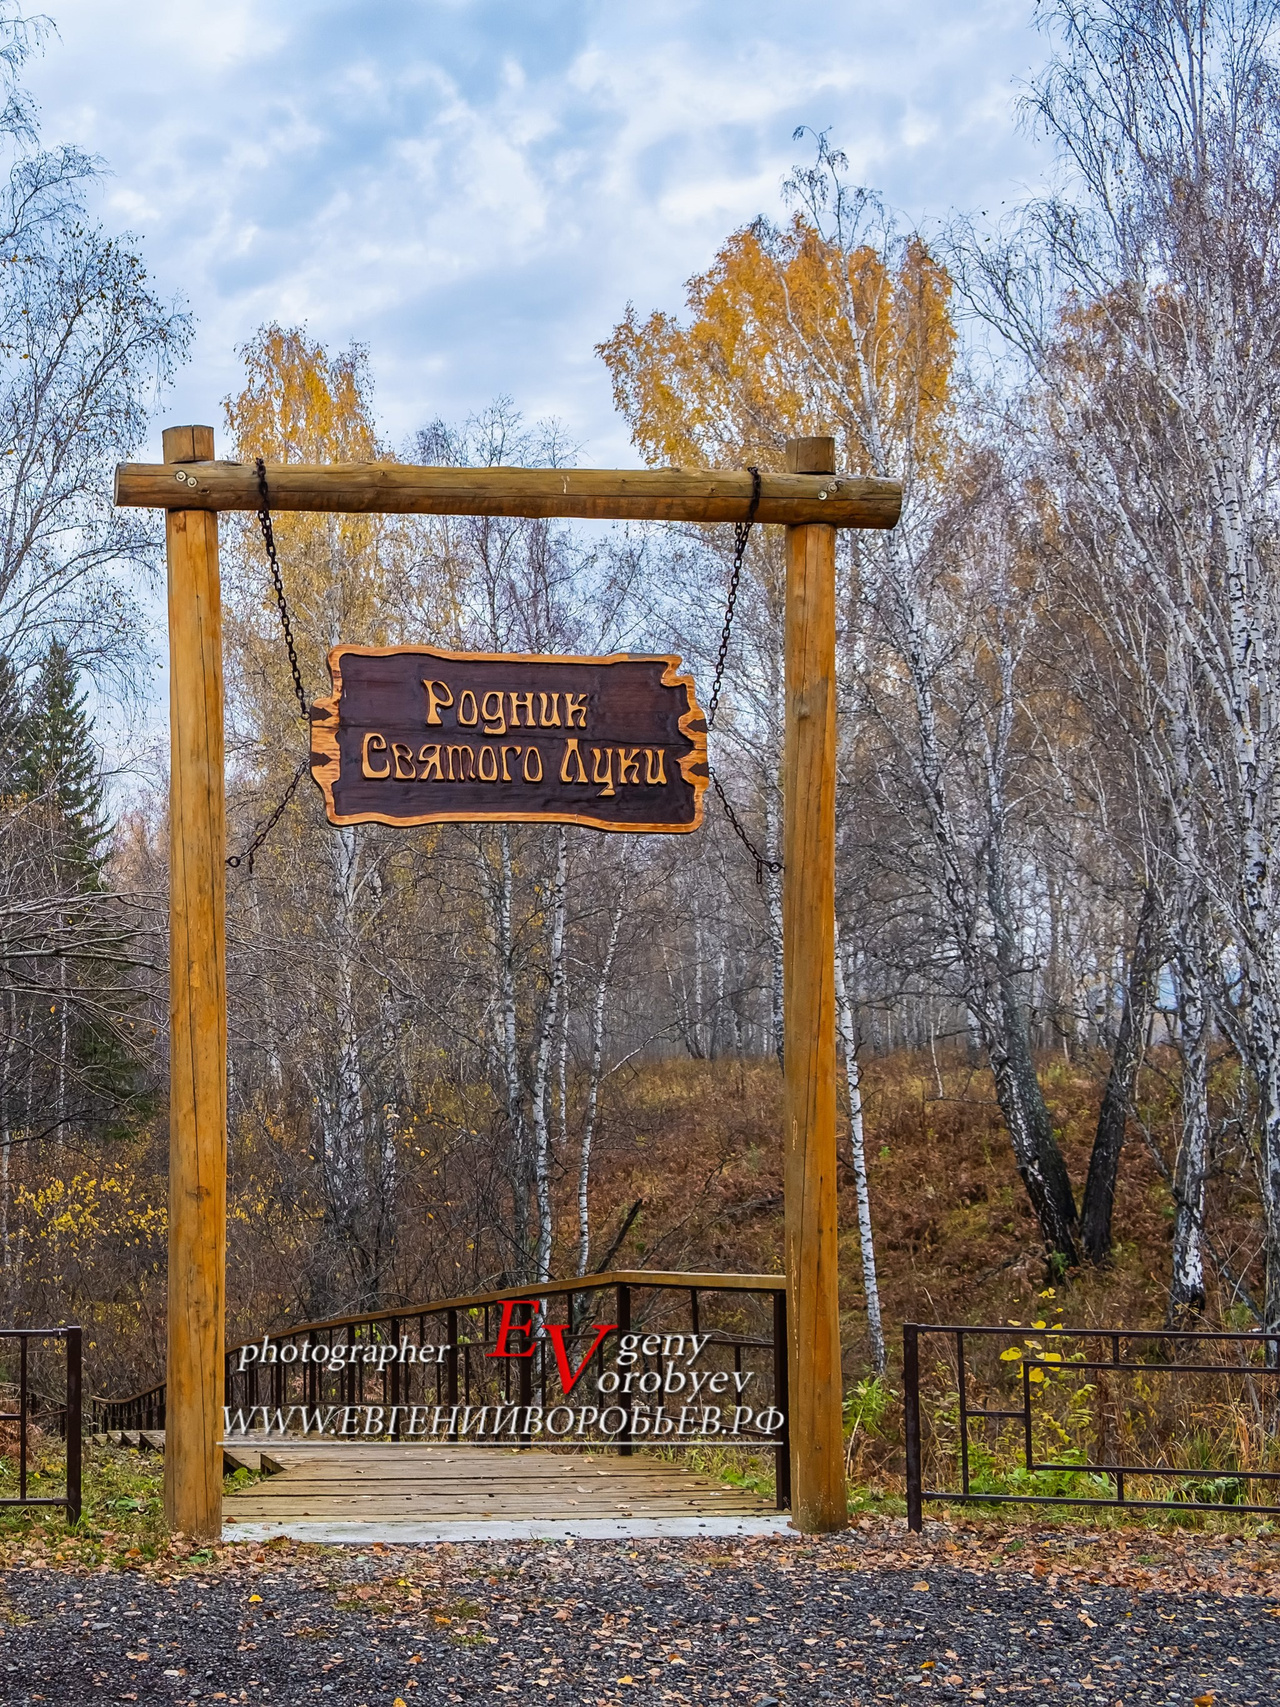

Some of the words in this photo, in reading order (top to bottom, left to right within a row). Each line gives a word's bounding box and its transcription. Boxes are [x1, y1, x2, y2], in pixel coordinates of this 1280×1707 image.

[422, 678, 589, 735] Родник
[361, 732, 543, 783] Святого
[560, 738, 667, 797] Луки
